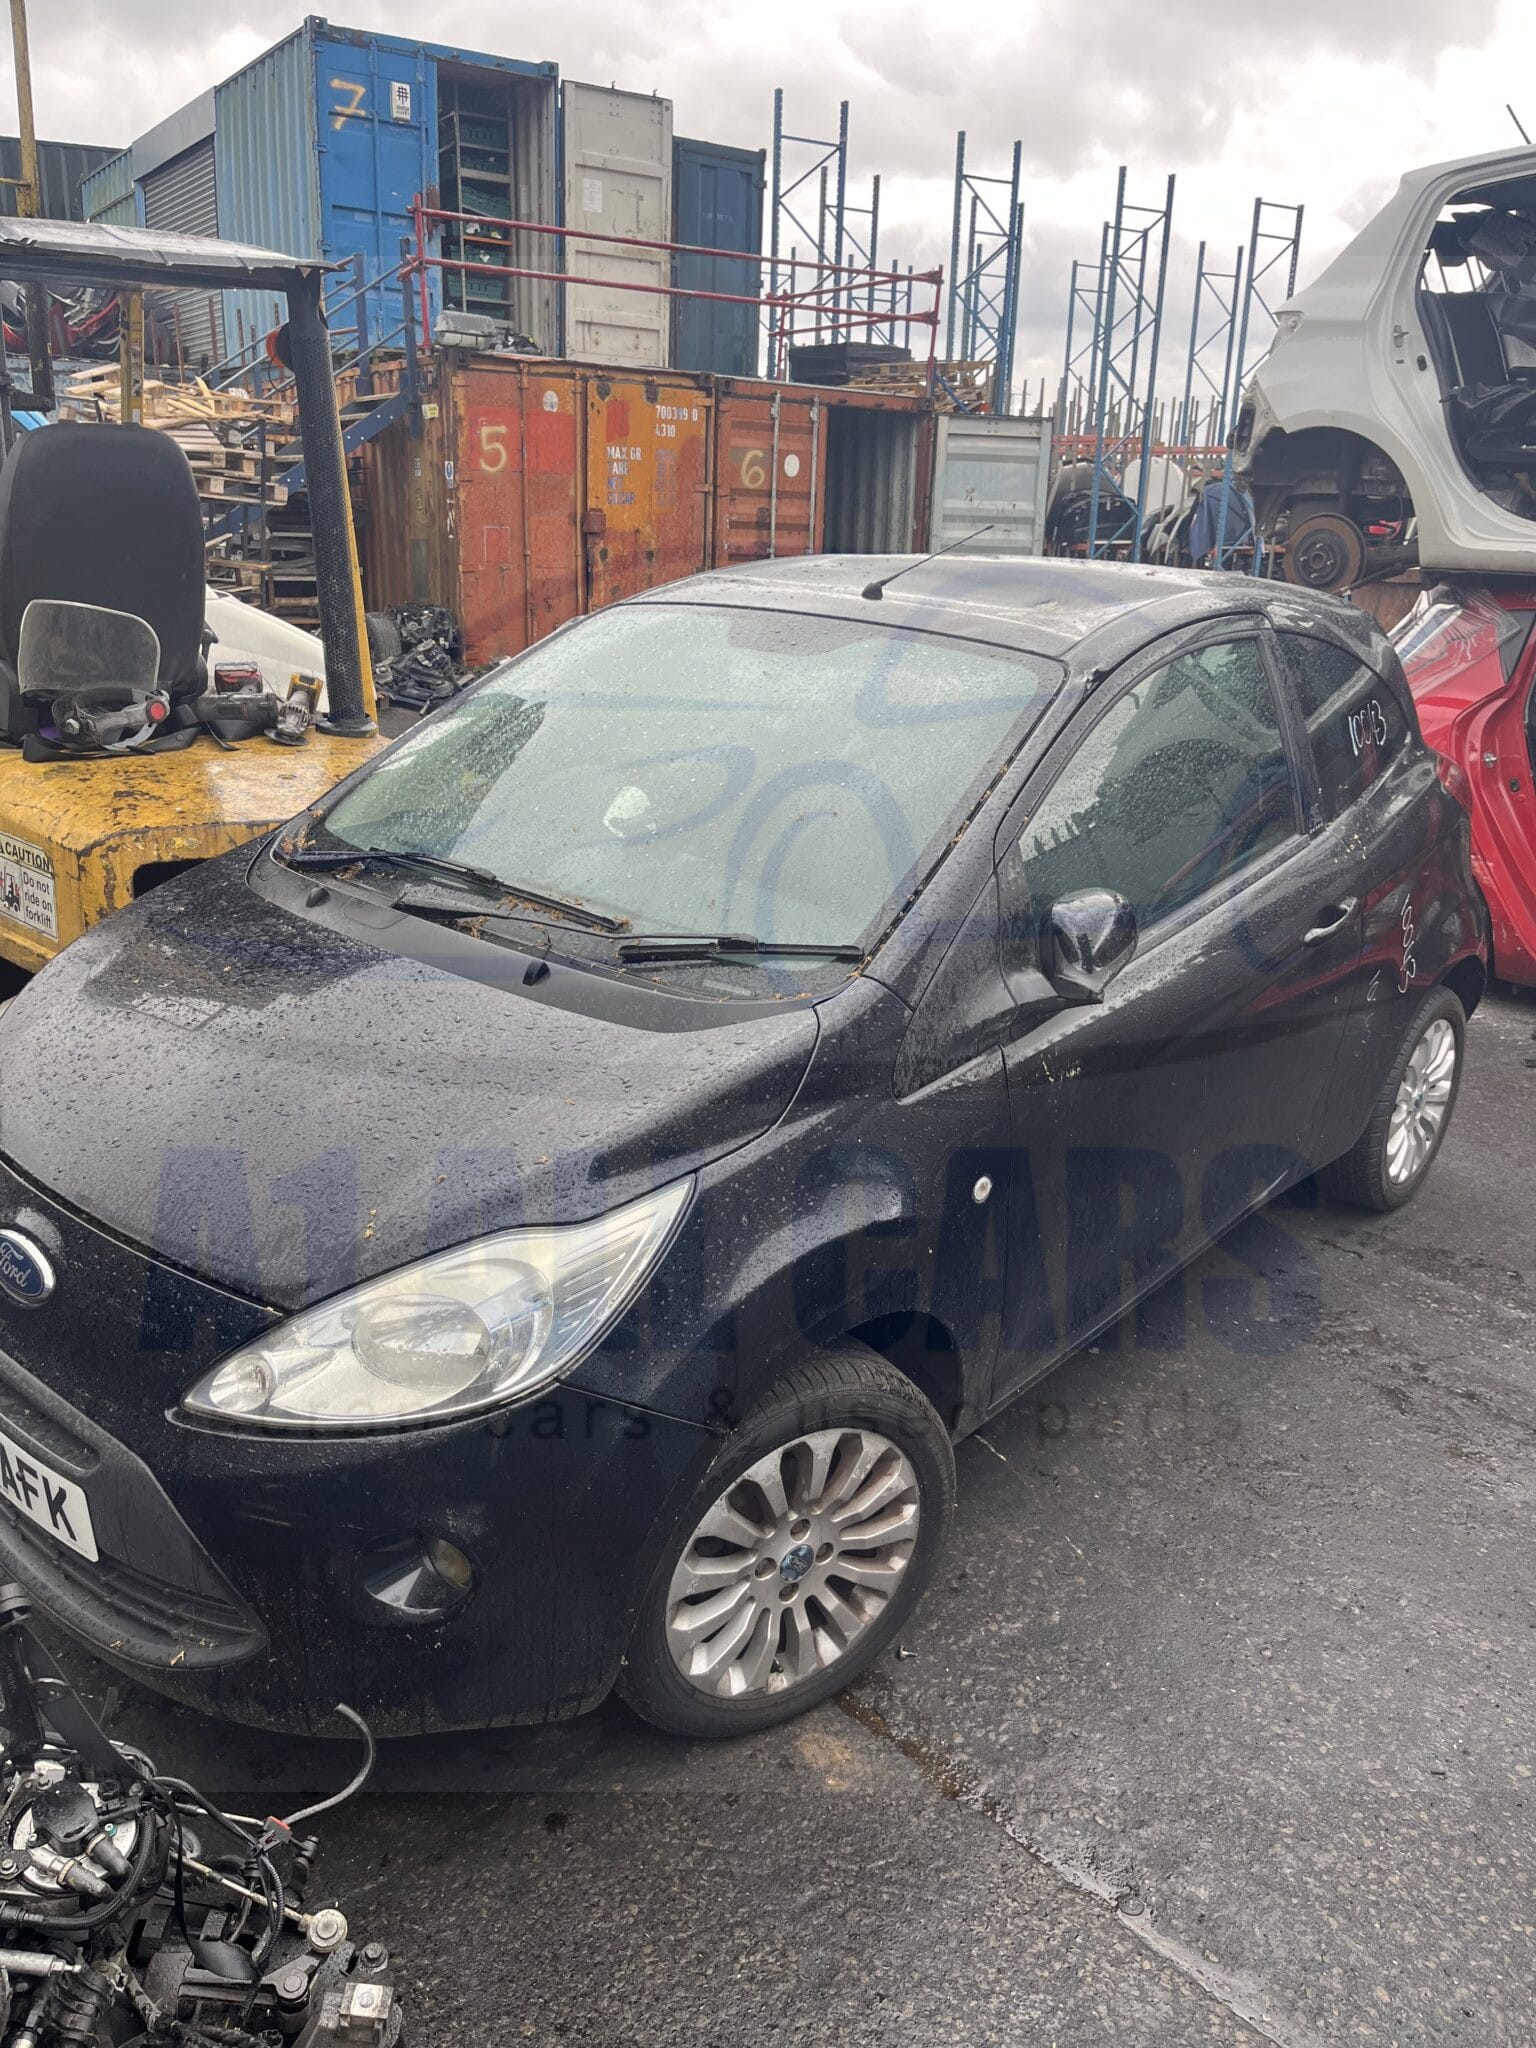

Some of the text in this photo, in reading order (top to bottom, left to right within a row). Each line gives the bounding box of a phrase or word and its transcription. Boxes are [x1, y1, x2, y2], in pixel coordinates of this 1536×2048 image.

[329, 78, 367, 131] 7
[479, 425, 508, 473] 5
[739, 449, 766, 489] 6
[5, 841, 50, 872] CAUTION
[23, 872, 50, 895] Do not
[24, 892, 53, 913] ride on
[25, 905, 53, 930] forklift
[0, 1242, 31, 1287] Ford
[0, 1442, 77, 1542] AFK
